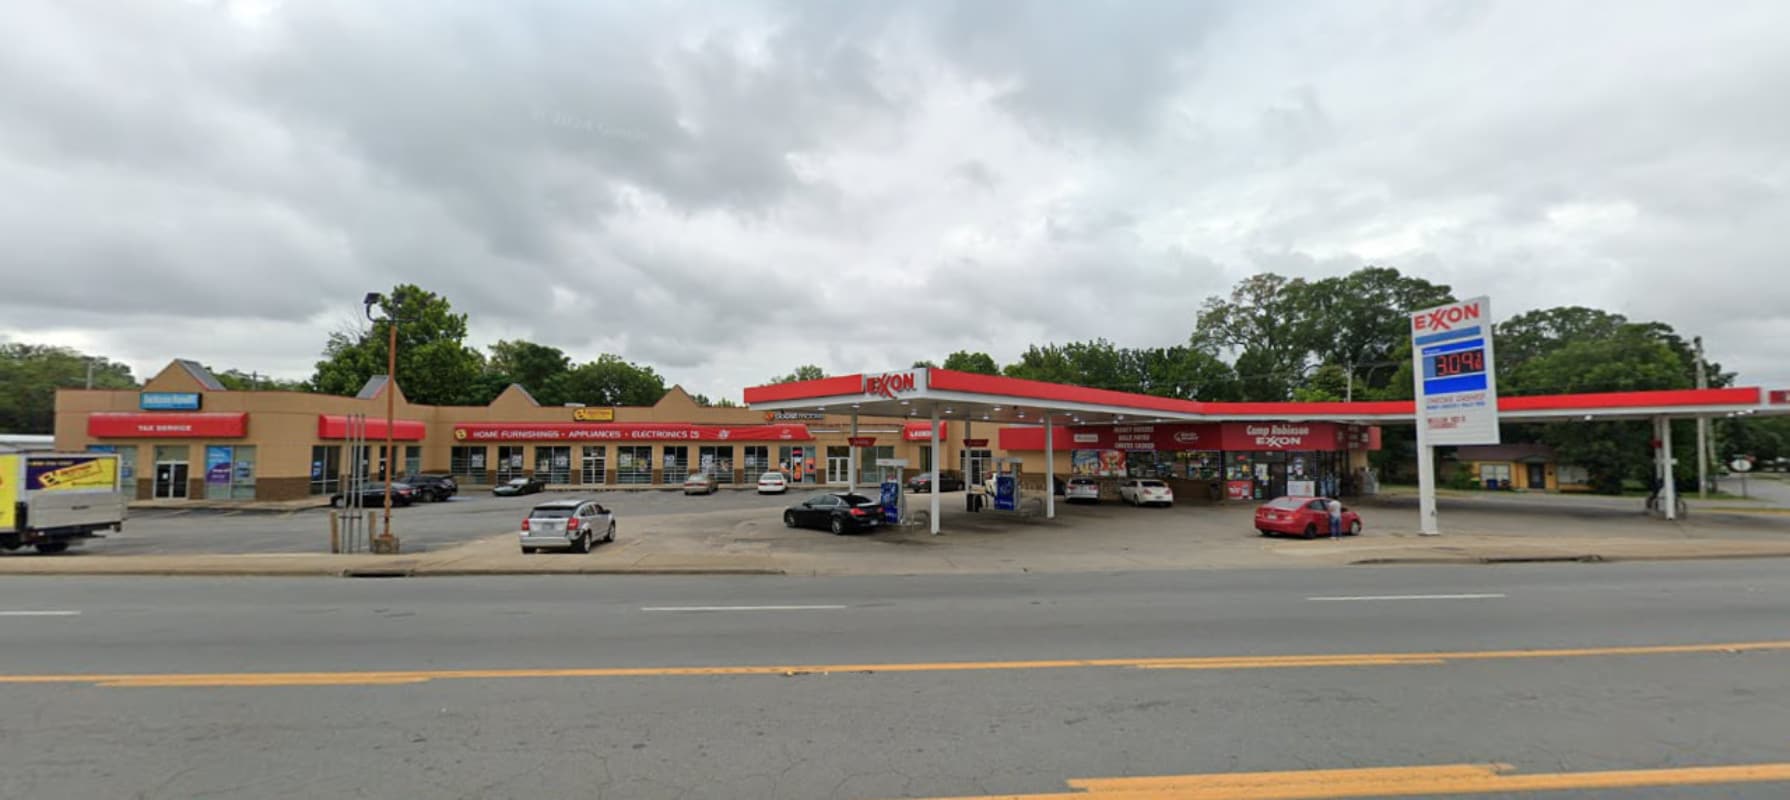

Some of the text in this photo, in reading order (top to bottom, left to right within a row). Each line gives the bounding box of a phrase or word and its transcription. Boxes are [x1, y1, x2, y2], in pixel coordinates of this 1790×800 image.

[1414, 303, 1479, 331] EXXON
[866, 373, 915, 399] EXXON
[473, 431, 687, 439] HOME FURNISHINGS APPLIANCES ELECTRONICS
[1246, 425, 1309, 436] Camp Robinson
[1255, 436, 1301, 448] EXXON
